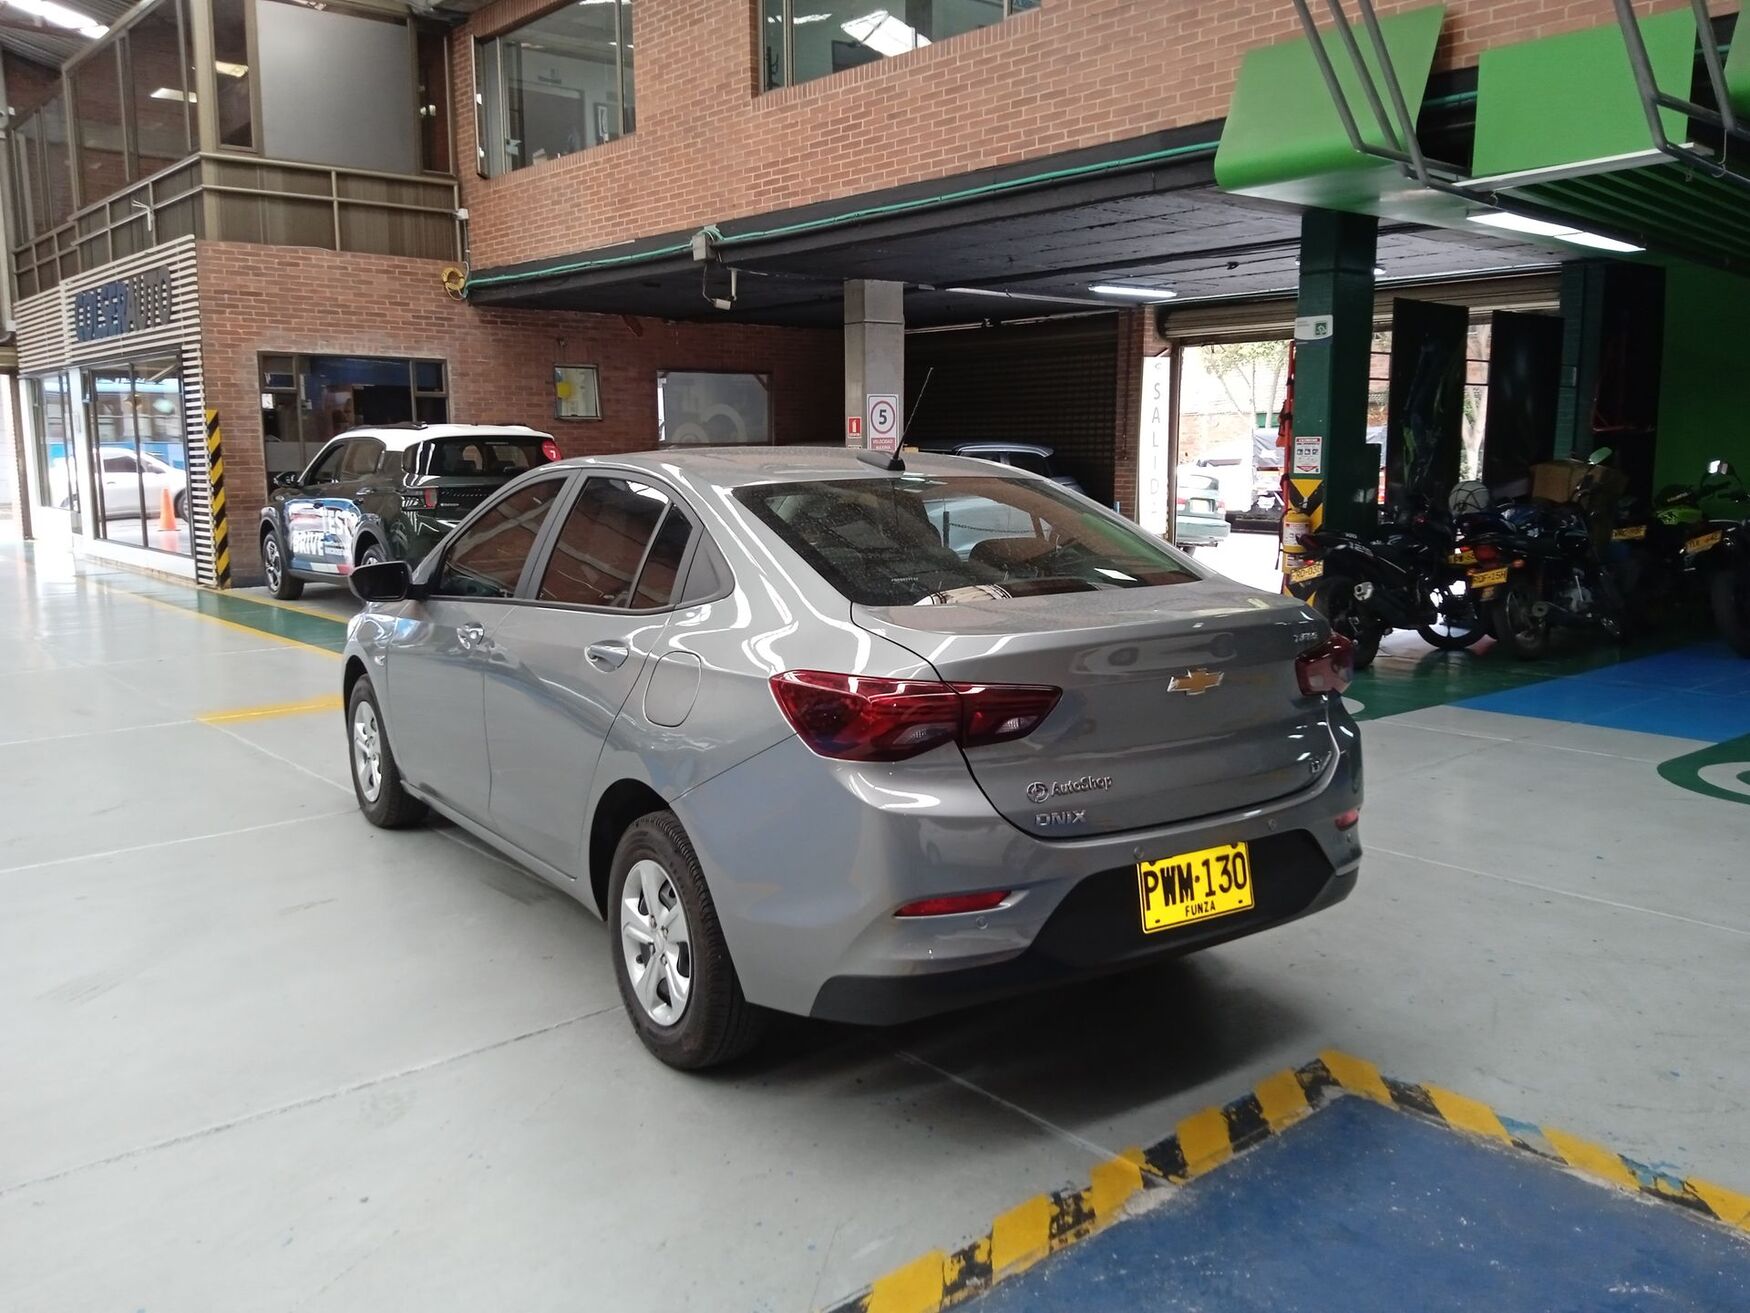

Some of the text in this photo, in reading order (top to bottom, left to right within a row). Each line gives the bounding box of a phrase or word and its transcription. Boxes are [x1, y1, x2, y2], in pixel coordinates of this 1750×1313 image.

[879, 408, 888, 425] 5
[293, 530, 325, 557] DRIVE
[1051, 776, 1113, 797] AutoShop
[1035, 809, 1087, 826] ONIX
[1185, 900, 1217, 918] FUNZA
